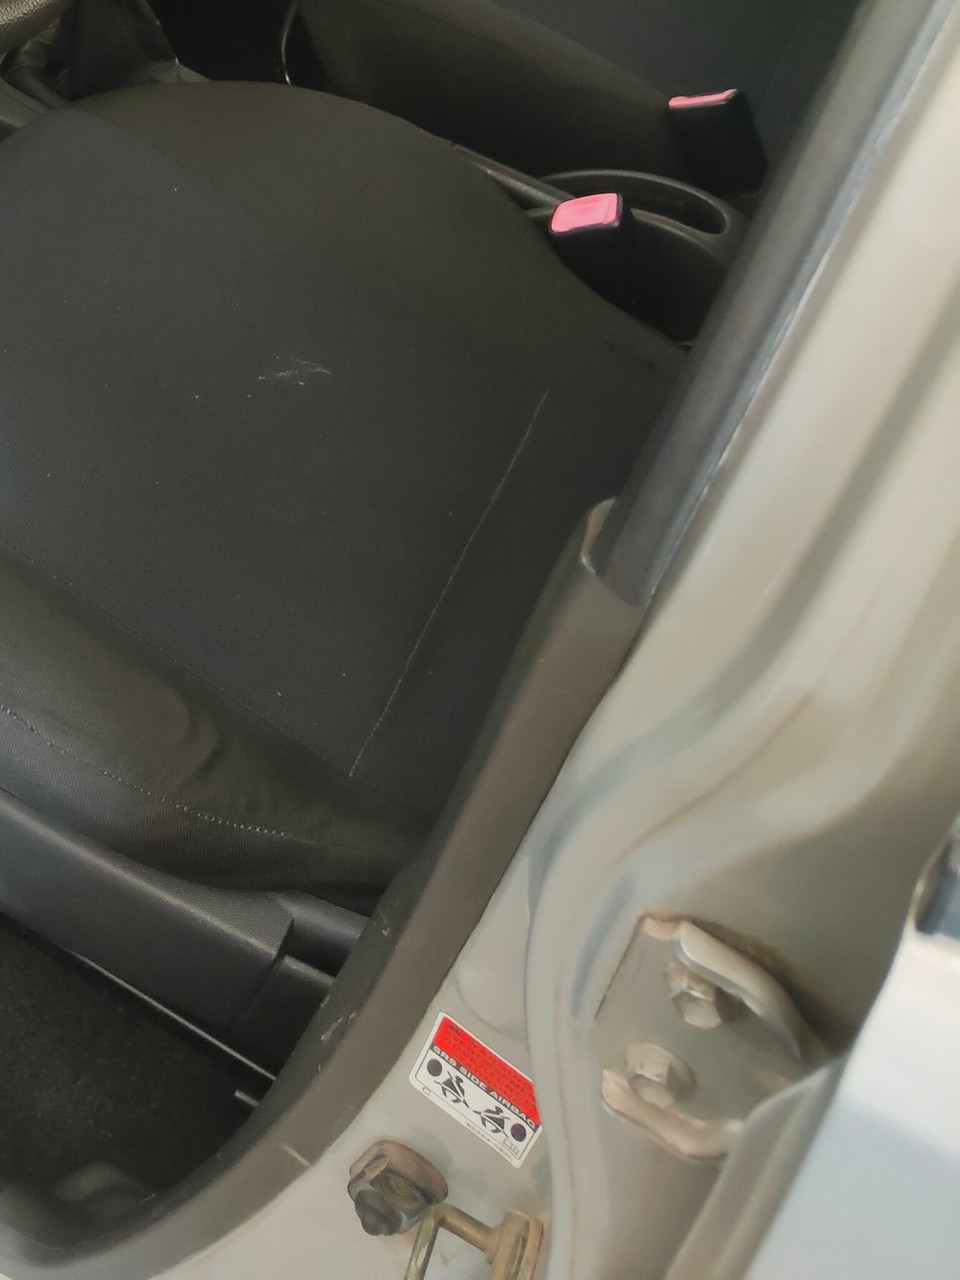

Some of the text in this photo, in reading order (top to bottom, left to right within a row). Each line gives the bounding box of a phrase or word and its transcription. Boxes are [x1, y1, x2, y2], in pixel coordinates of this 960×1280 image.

[432, 1045, 538, 1130] SRS SIDE AIRBAG
